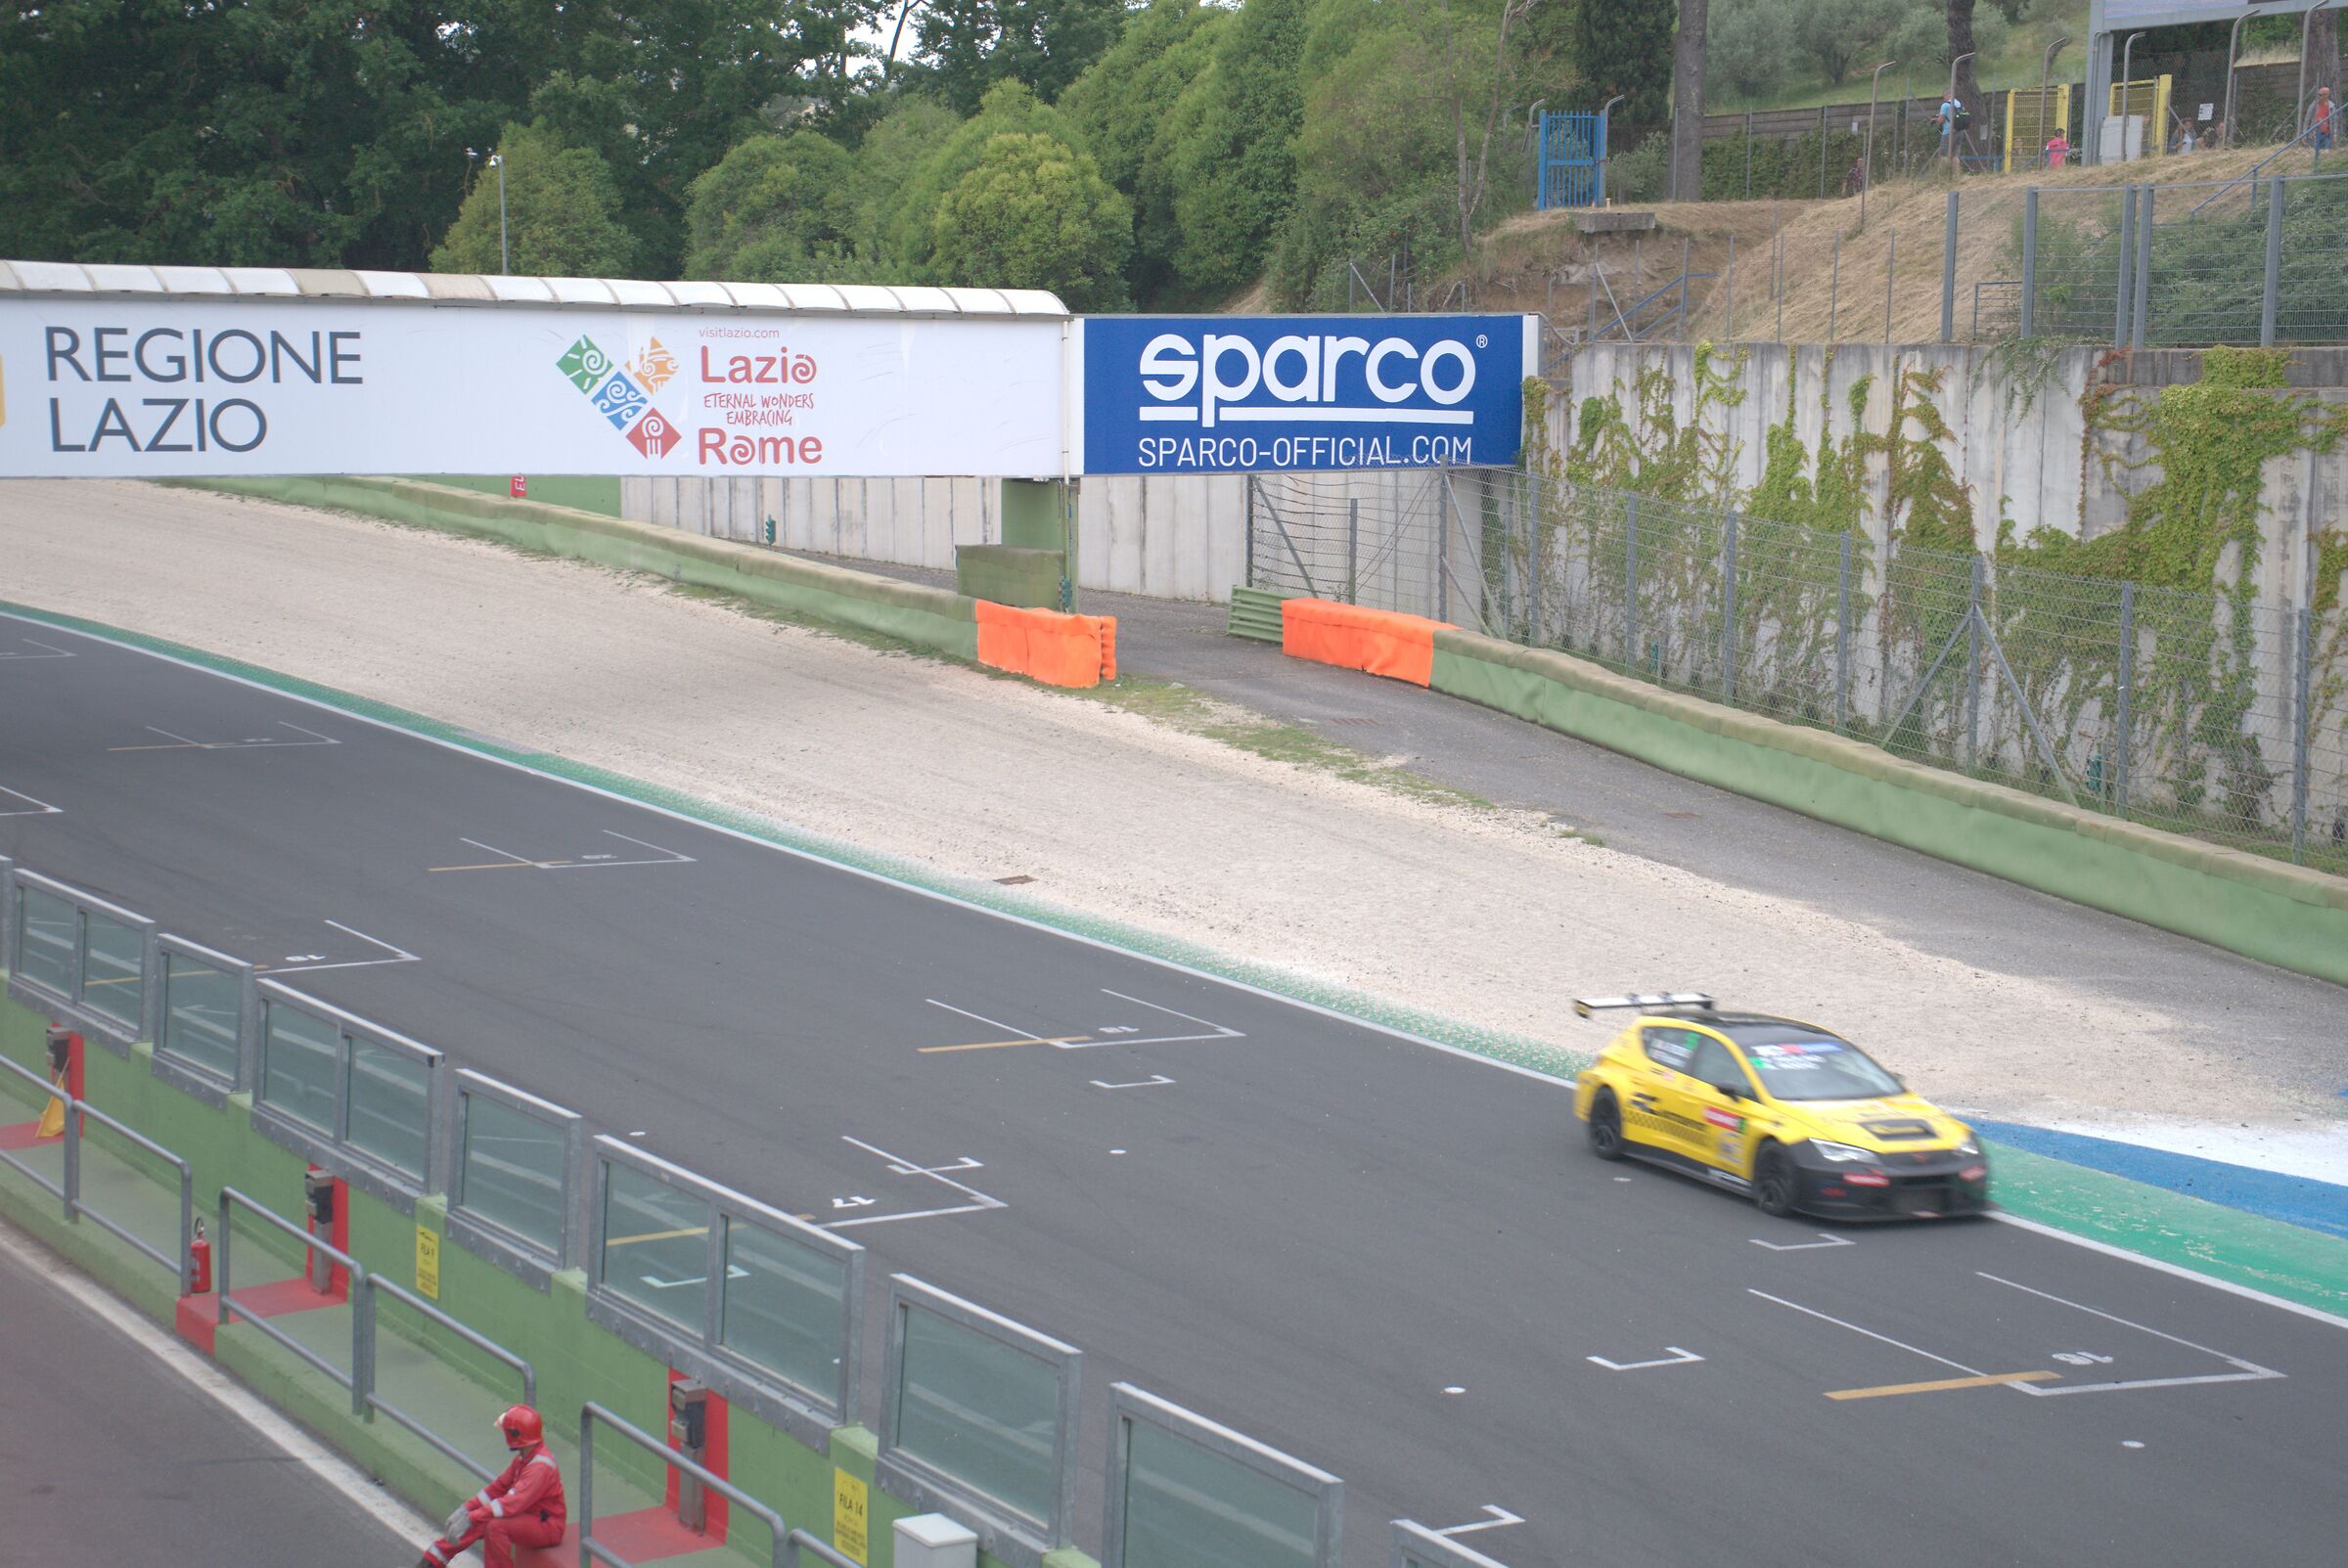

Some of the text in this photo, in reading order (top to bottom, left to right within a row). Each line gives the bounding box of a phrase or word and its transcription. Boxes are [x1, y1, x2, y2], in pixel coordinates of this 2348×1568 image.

[700, 327, 780, 338] visitlazio.com
[45, 326, 363, 384] REGIONE
[701, 345, 818, 384] Lazio
[1140, 334, 1476, 427] sparco
[703, 392, 814, 410] ETERNAL WONDERS
[726, 409, 792, 426] EMBRACING
[50, 397, 267, 452] LAZIO
[699, 426, 823, 466] Rome
[1138, 434, 1471, 467] SPARCO-OFFICIAL.COM
